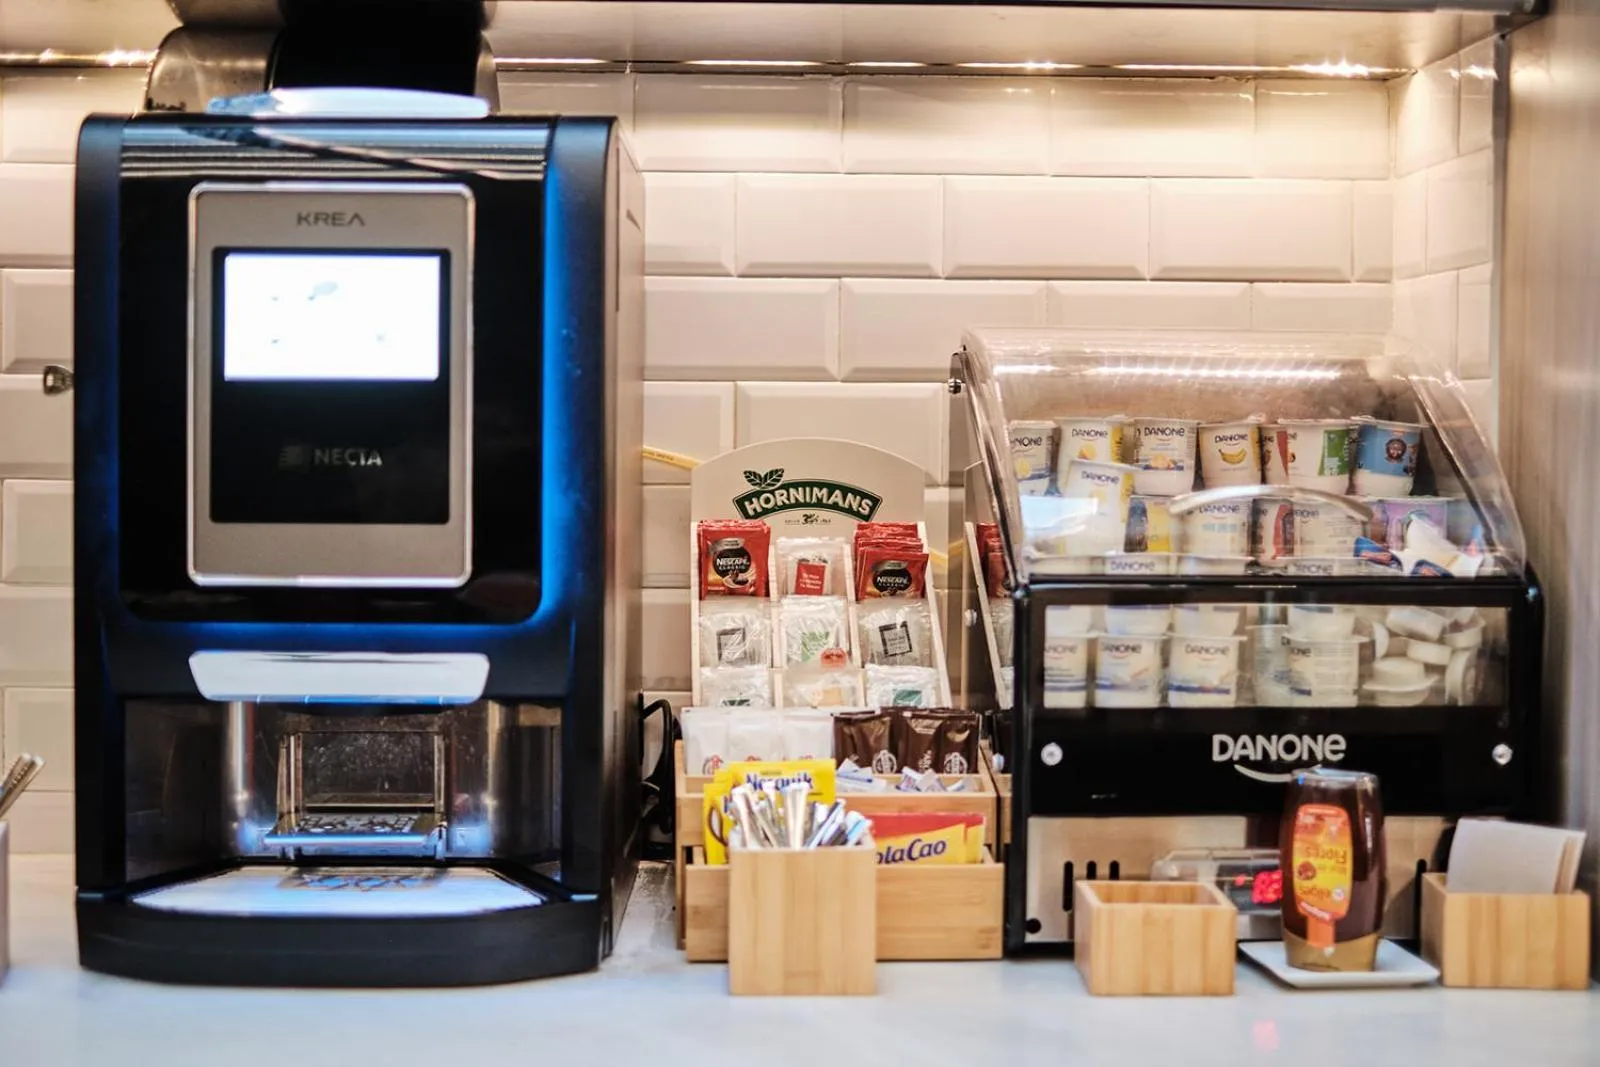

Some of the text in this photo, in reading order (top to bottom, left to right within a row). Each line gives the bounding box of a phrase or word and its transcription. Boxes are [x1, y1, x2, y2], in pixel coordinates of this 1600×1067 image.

[297, 212, 365, 227] KREA
[313, 448, 382, 466] NECTA
[744, 487, 872, 516] HORNIMANS
